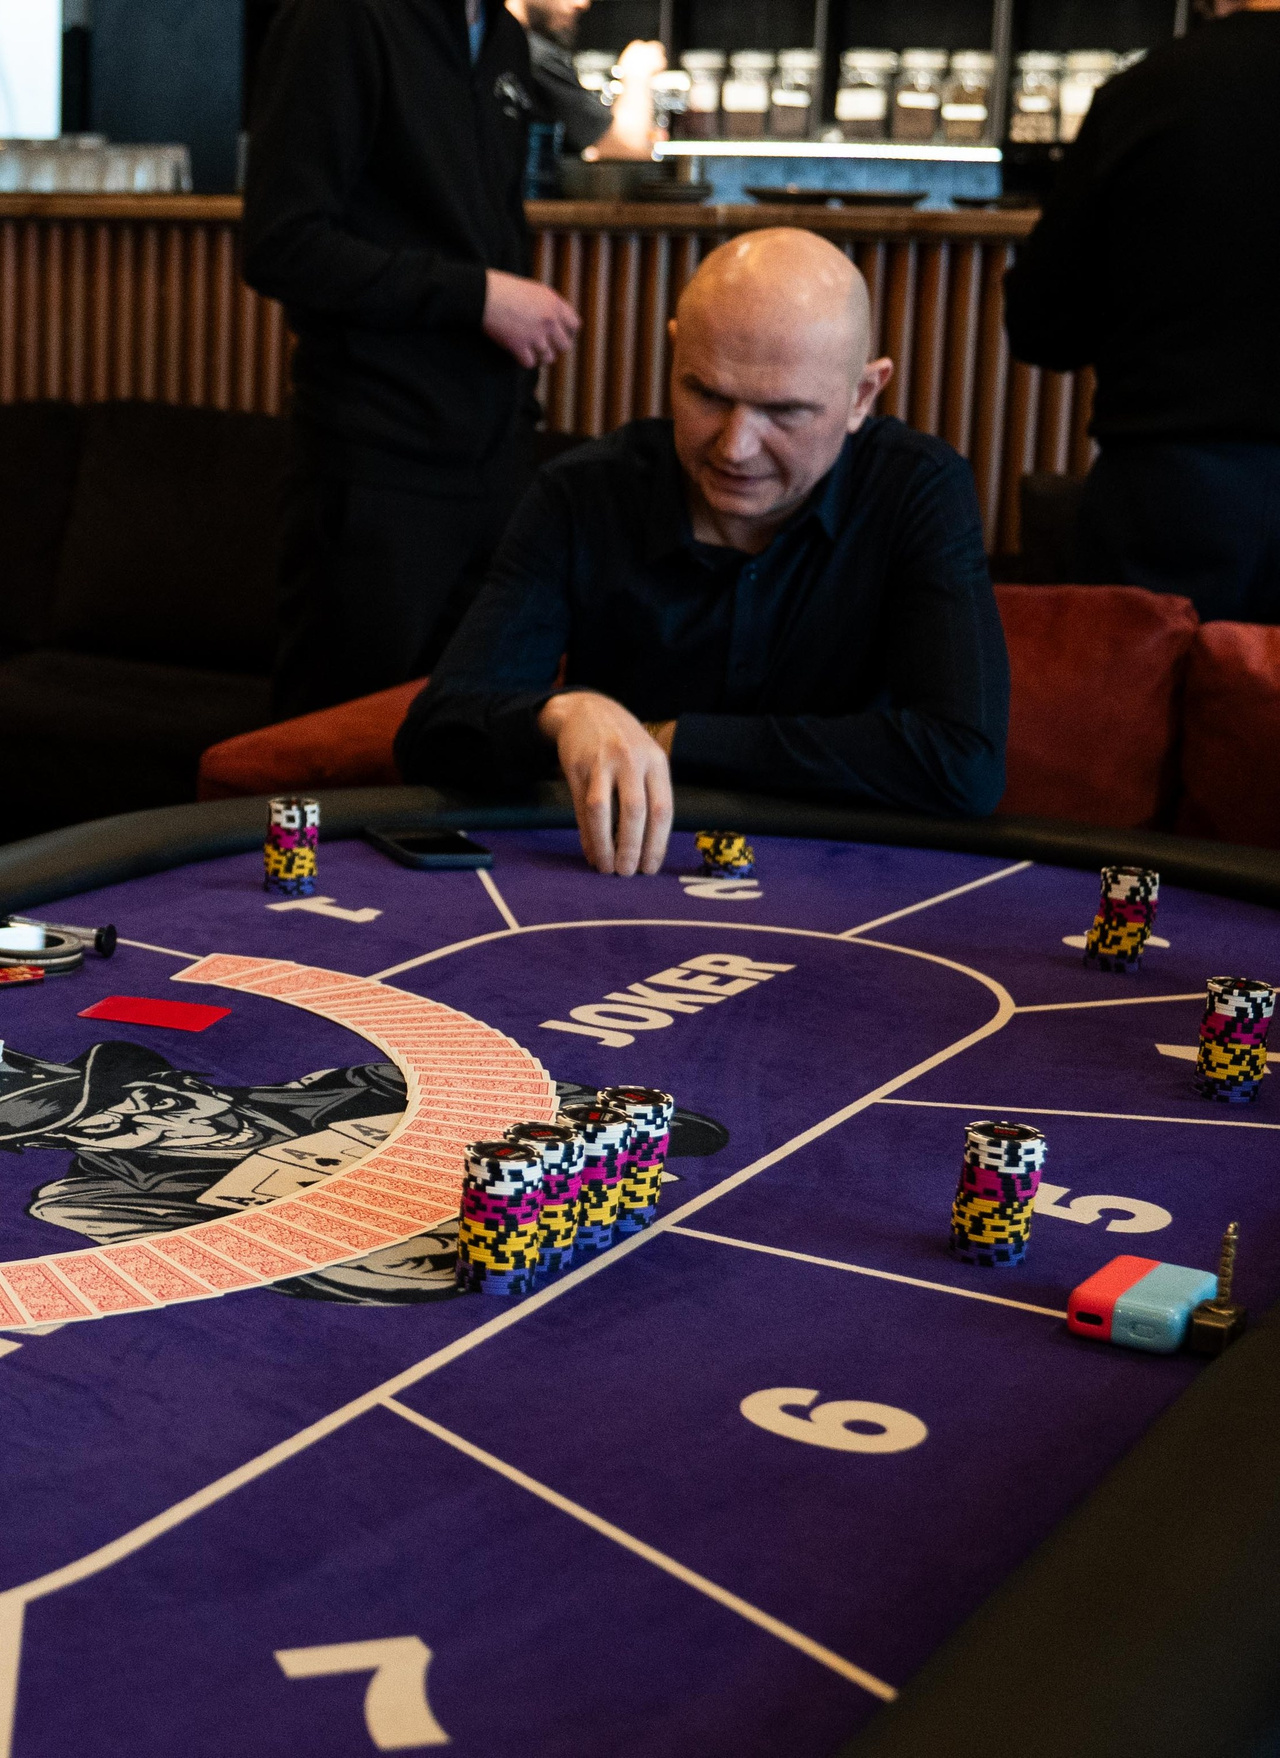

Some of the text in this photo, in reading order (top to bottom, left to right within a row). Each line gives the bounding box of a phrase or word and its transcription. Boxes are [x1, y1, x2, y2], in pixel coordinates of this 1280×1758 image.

[265, 896, 383, 923] 1
[678, 875, 763, 900] 2
[538, 953, 797, 1048] JOKER
[1033, 1182, 1173, 1233] 5
[739, 1387, 928, 1453] 6
[274, 1635, 450, 1751] 7
